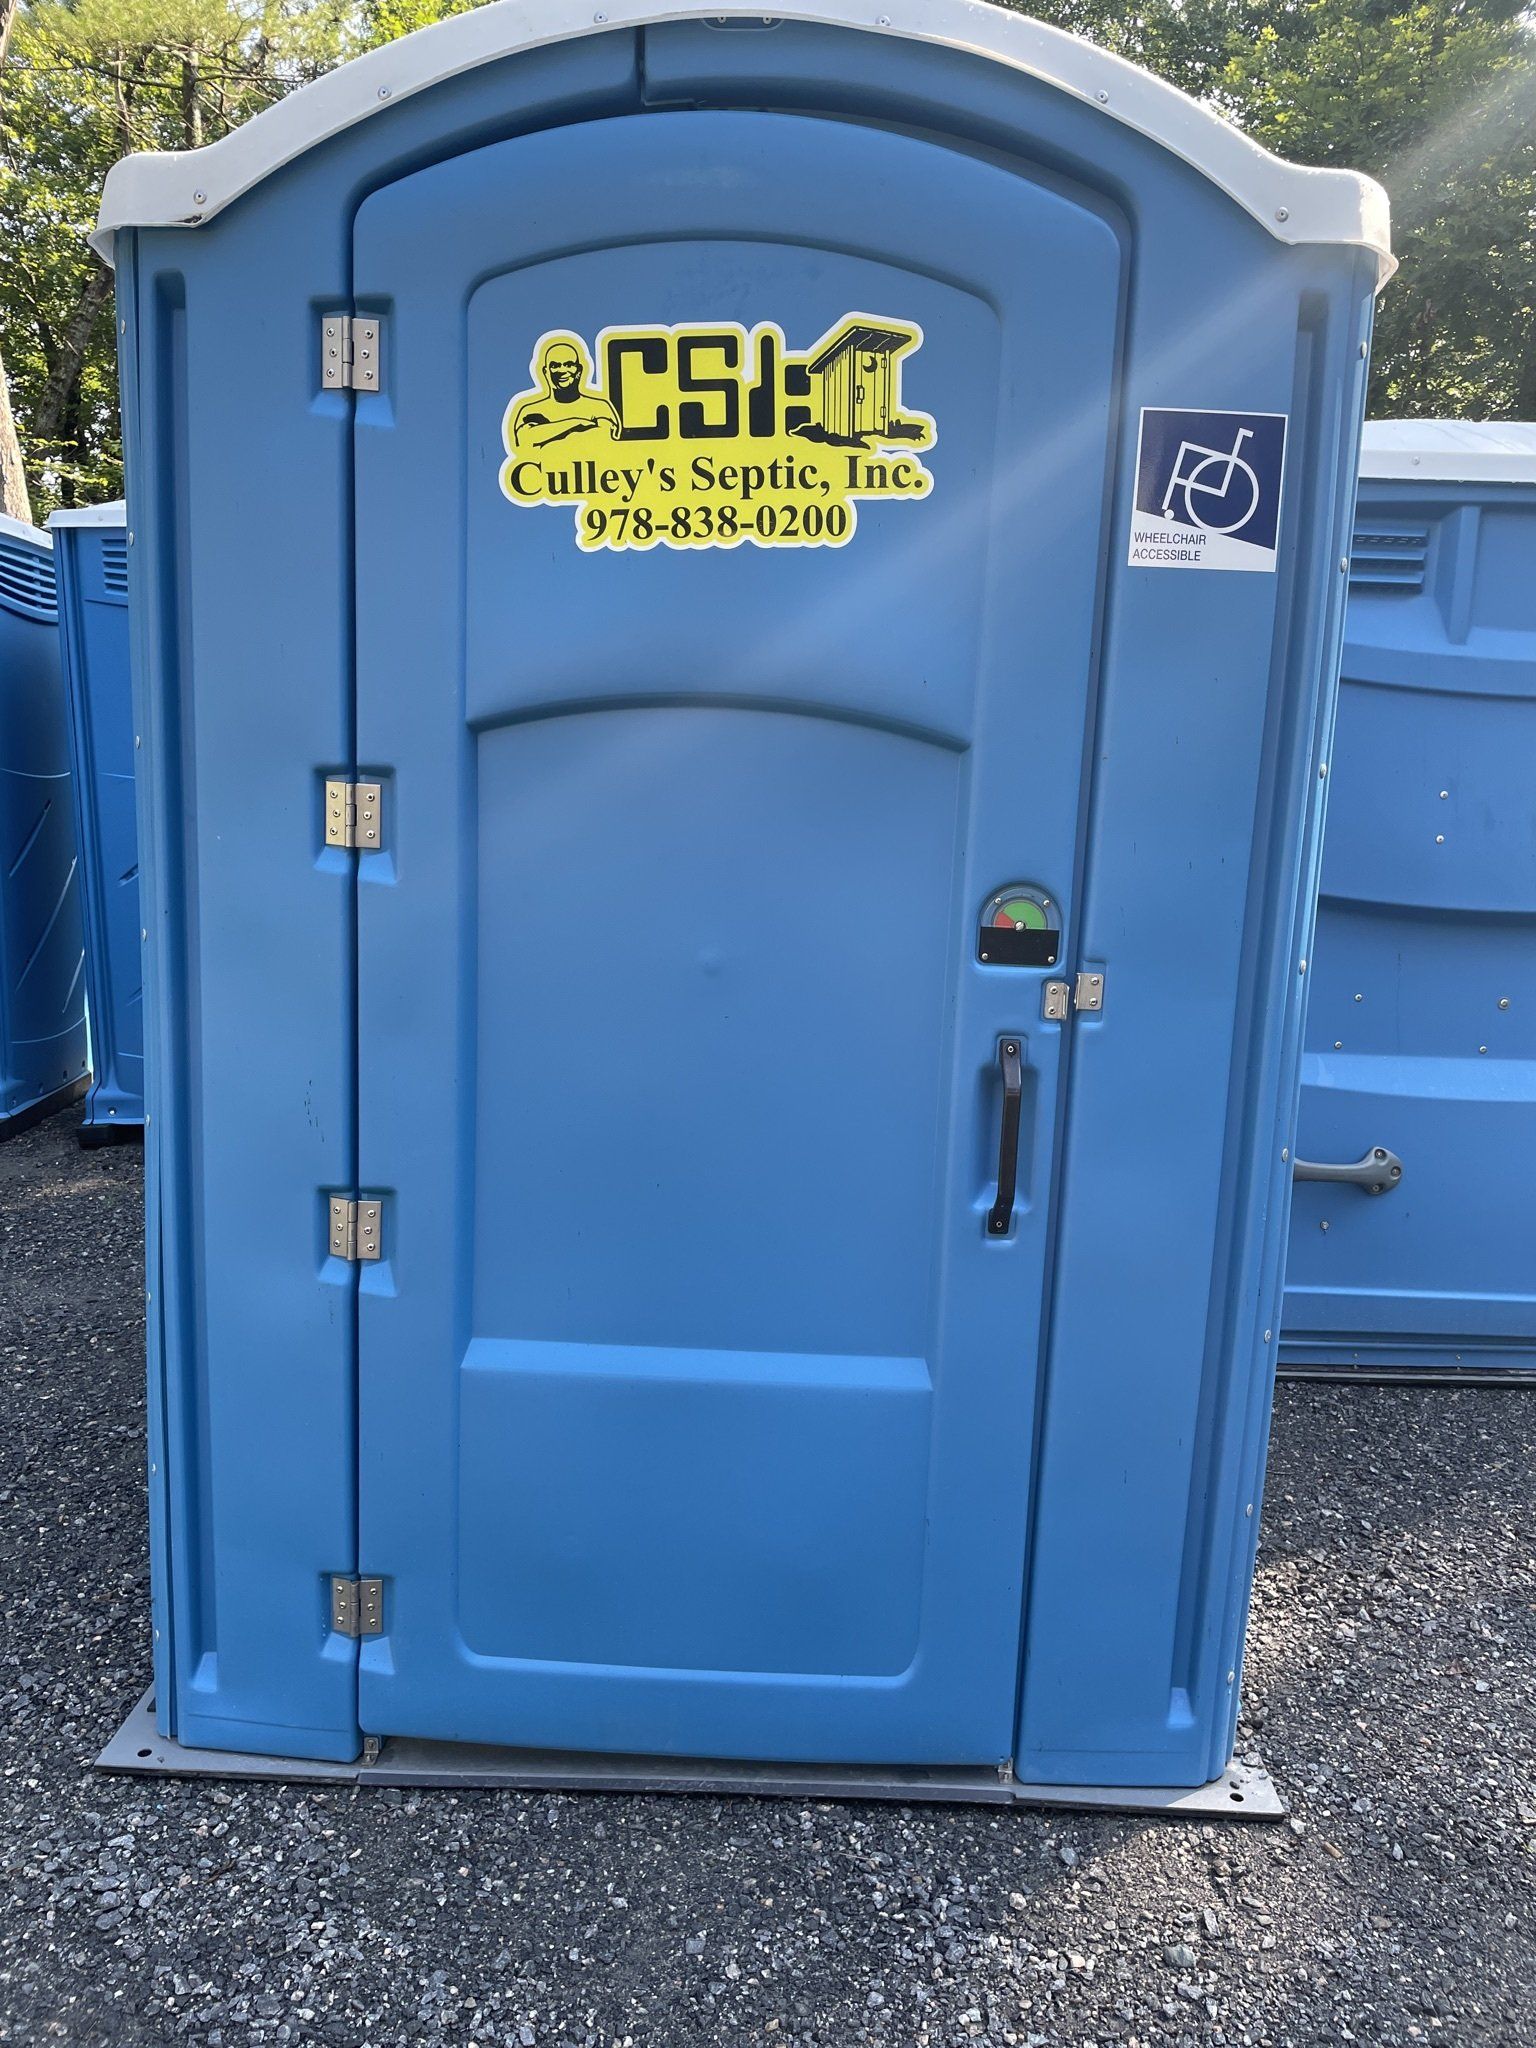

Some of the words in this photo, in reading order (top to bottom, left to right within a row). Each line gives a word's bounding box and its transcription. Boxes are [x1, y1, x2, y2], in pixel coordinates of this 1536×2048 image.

[510, 459, 676, 503] Culley's
[691, 455, 830, 500] Septic,
[844, 454, 924, 490] Inc.
[586, 504, 846, 542] 978-838-0200
[1134, 532, 1206, 545] WHEELCHAIR
[1133, 548, 1201, 561] ACCESSIBLE
